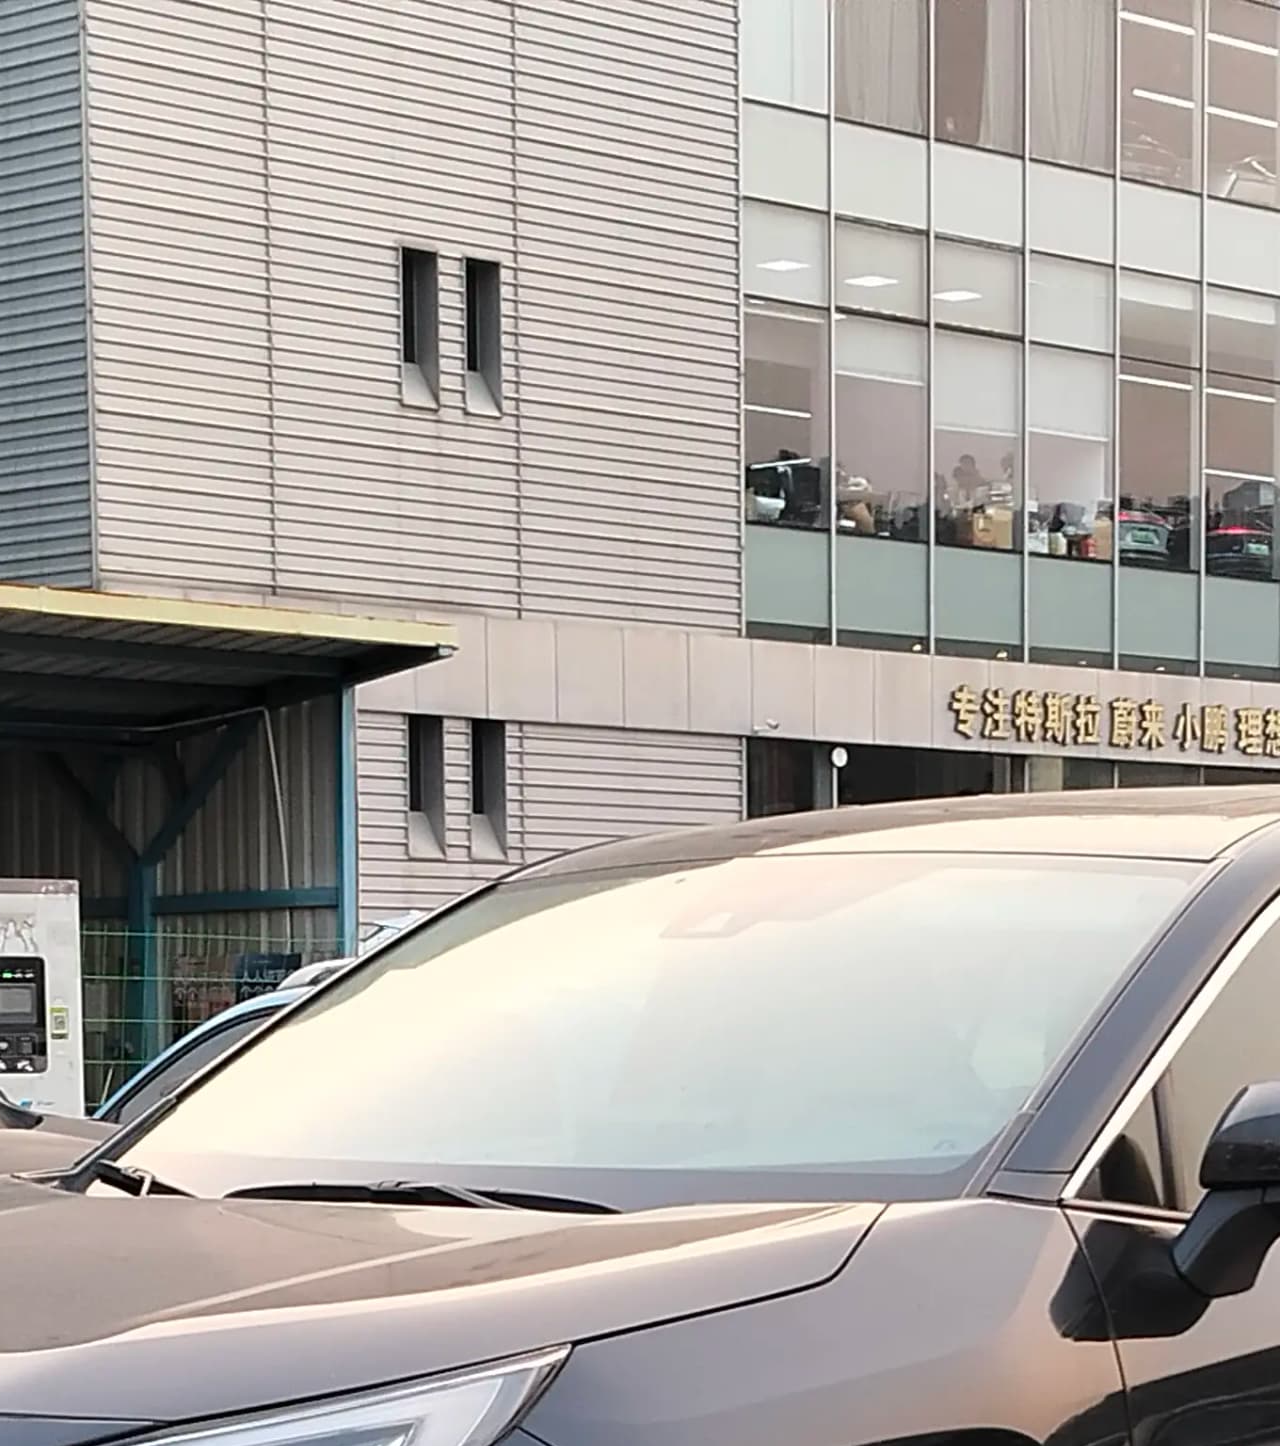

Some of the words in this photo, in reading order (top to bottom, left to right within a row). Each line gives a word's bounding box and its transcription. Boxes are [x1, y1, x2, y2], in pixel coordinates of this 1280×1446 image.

[950, 684, 1102, 745] 专注特斯拉
[1109, 698, 1166, 749] 蔚来
[1173, 702, 1228, 753] 小鹏
